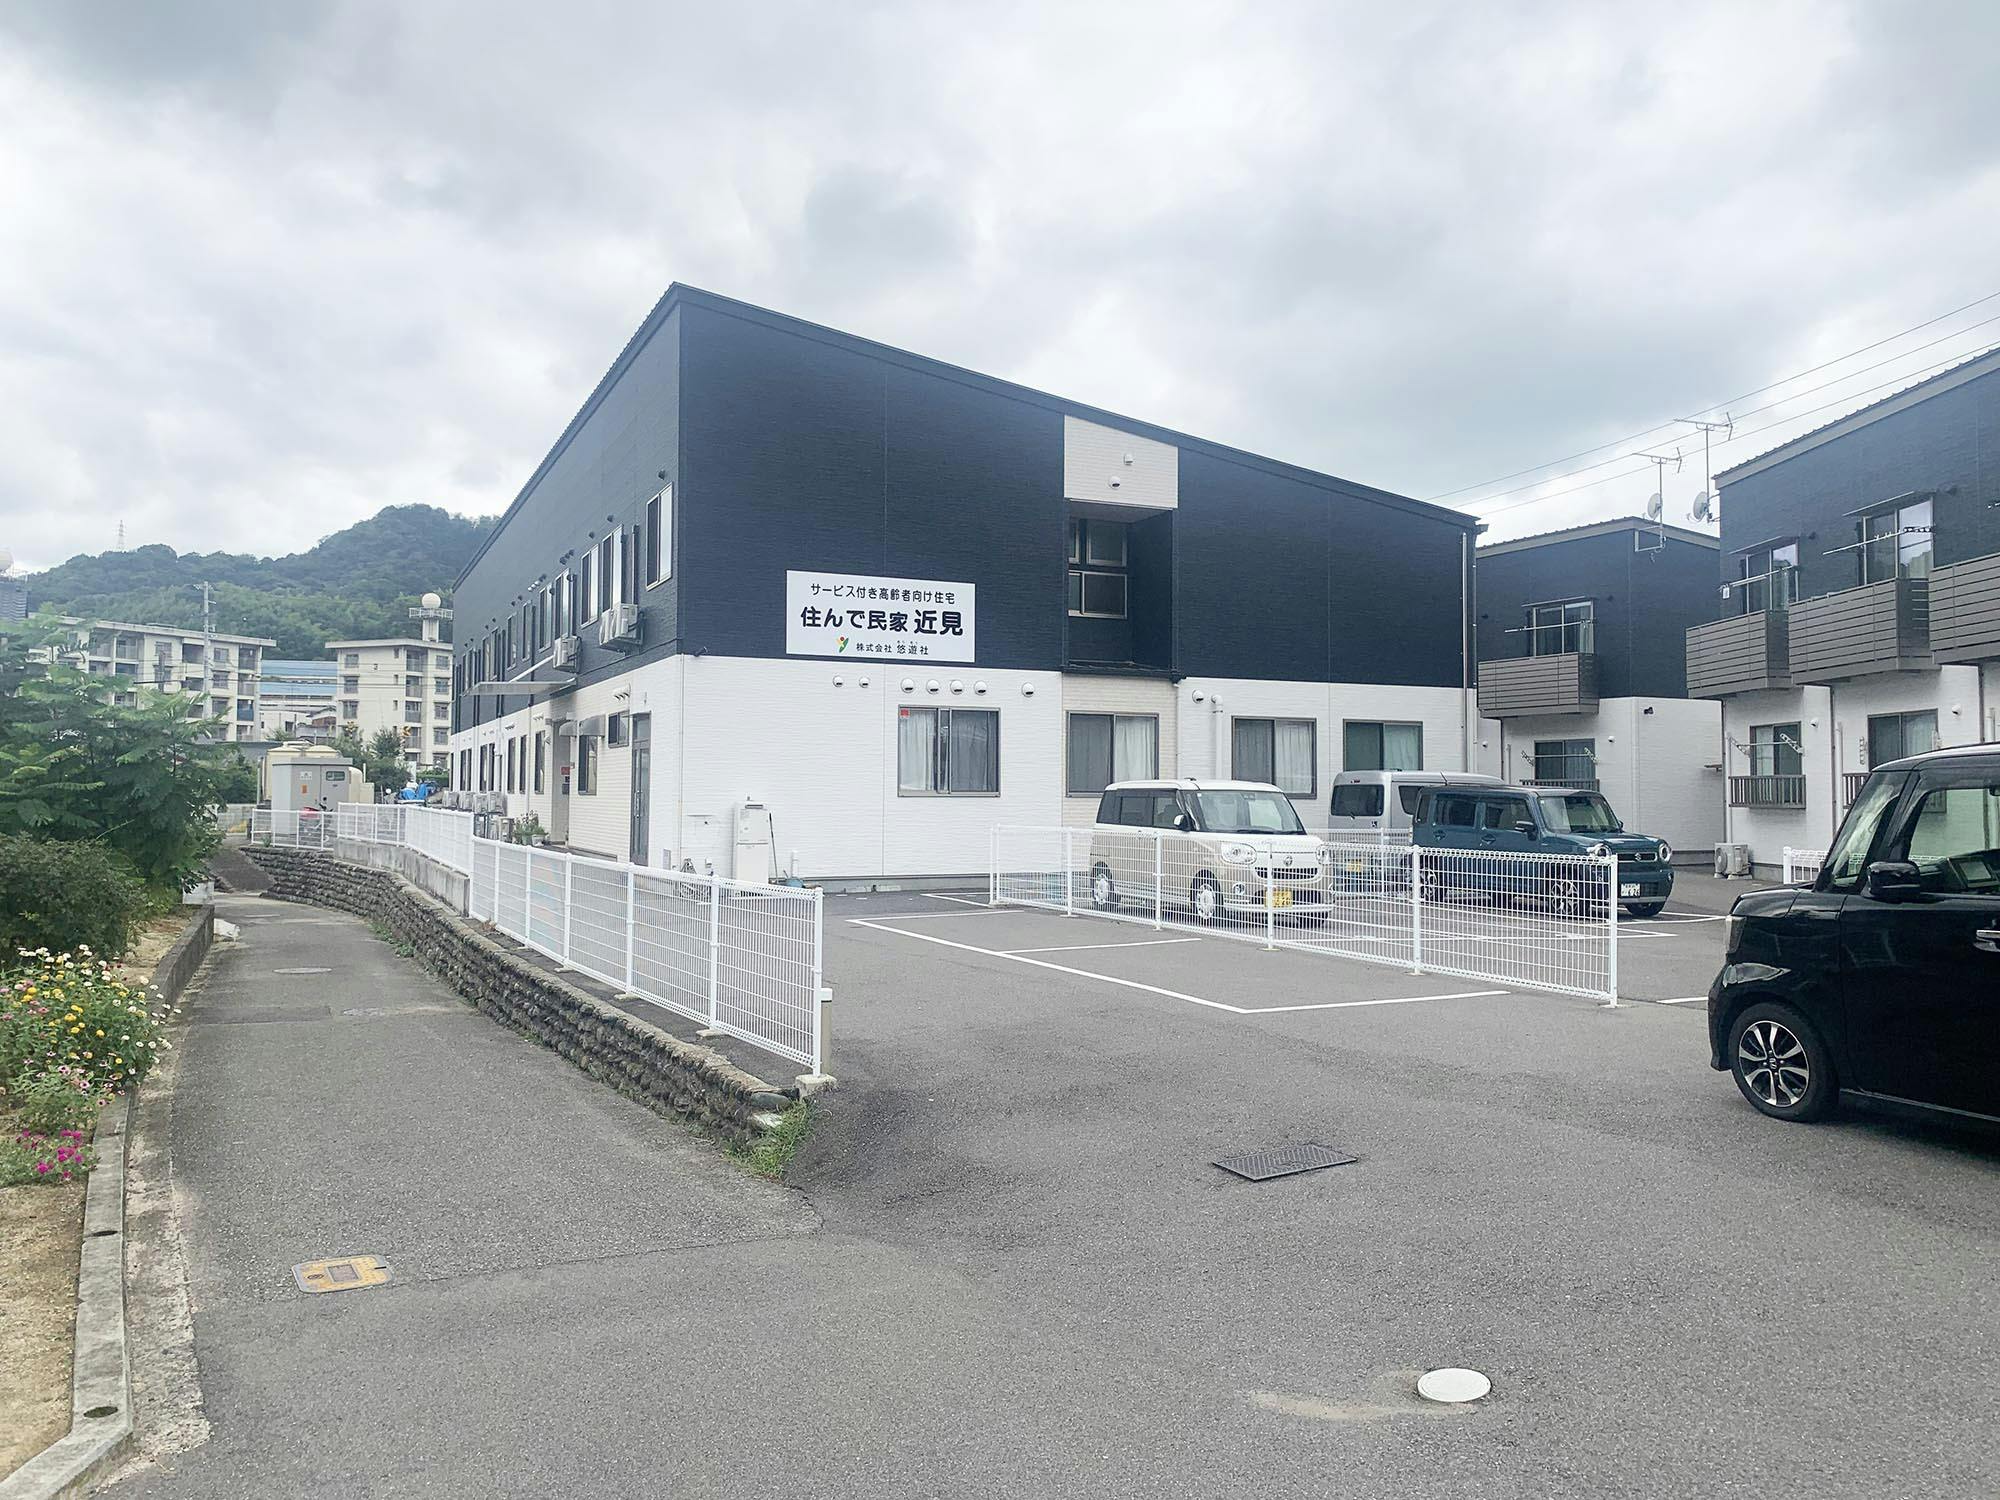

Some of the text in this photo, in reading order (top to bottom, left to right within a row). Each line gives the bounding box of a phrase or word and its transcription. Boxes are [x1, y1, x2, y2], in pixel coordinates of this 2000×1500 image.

[810, 583, 955, 605] サービス付き高齢者向け住宅
